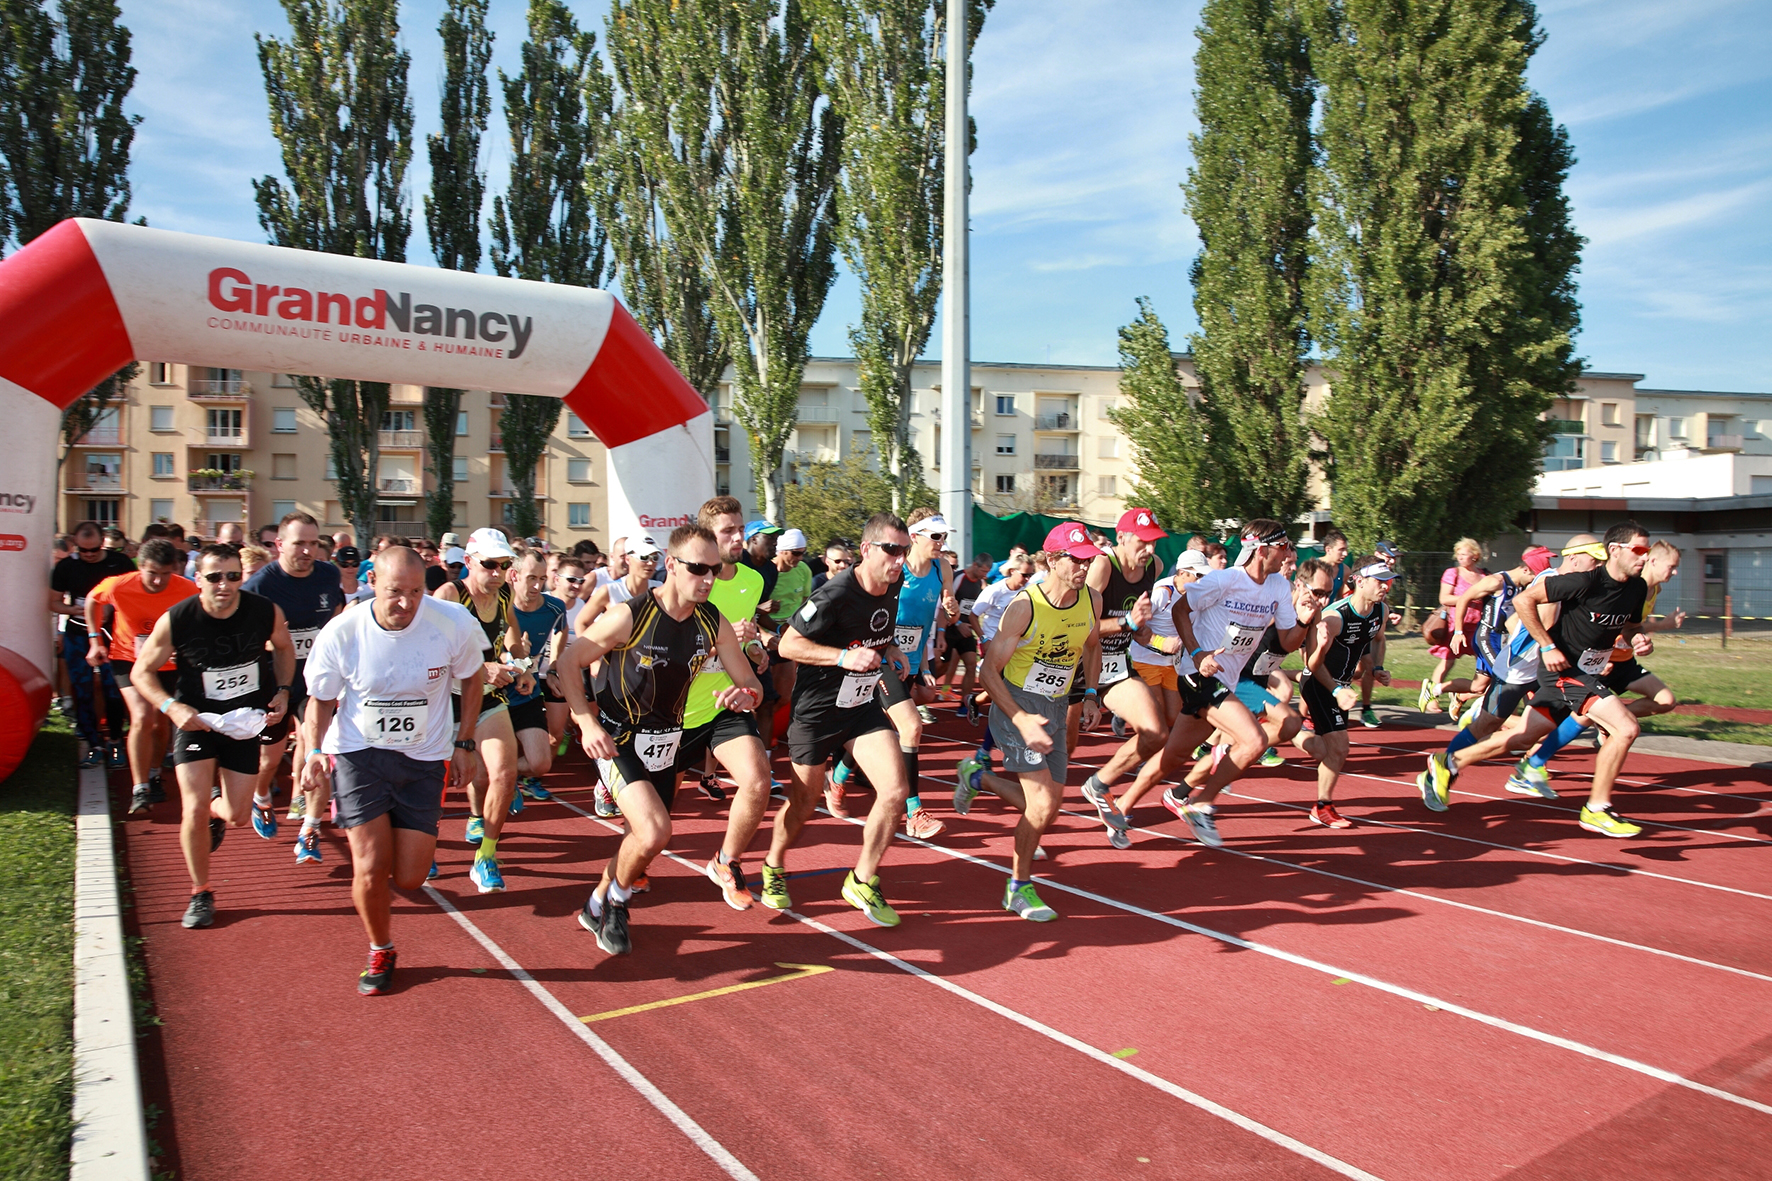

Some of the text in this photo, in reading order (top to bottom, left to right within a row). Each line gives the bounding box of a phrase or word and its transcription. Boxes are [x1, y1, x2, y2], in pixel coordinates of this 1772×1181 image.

[338, 331, 412, 350] URBAINE
[417, 340, 427, 351] &
[433, 342, 504, 359] HUMAINE
[1224, 600, 1270, 614] E.LECLERC
[1231, 636, 1254, 646] 518
[1583, 657, 1605, 666] 250
[215, 674, 249, 690] 252
[1034, 672, 1067, 687] 285
[855, 684, 872, 697] 15
[376, 717, 415, 732] 126
[643, 742, 674, 759] 477
